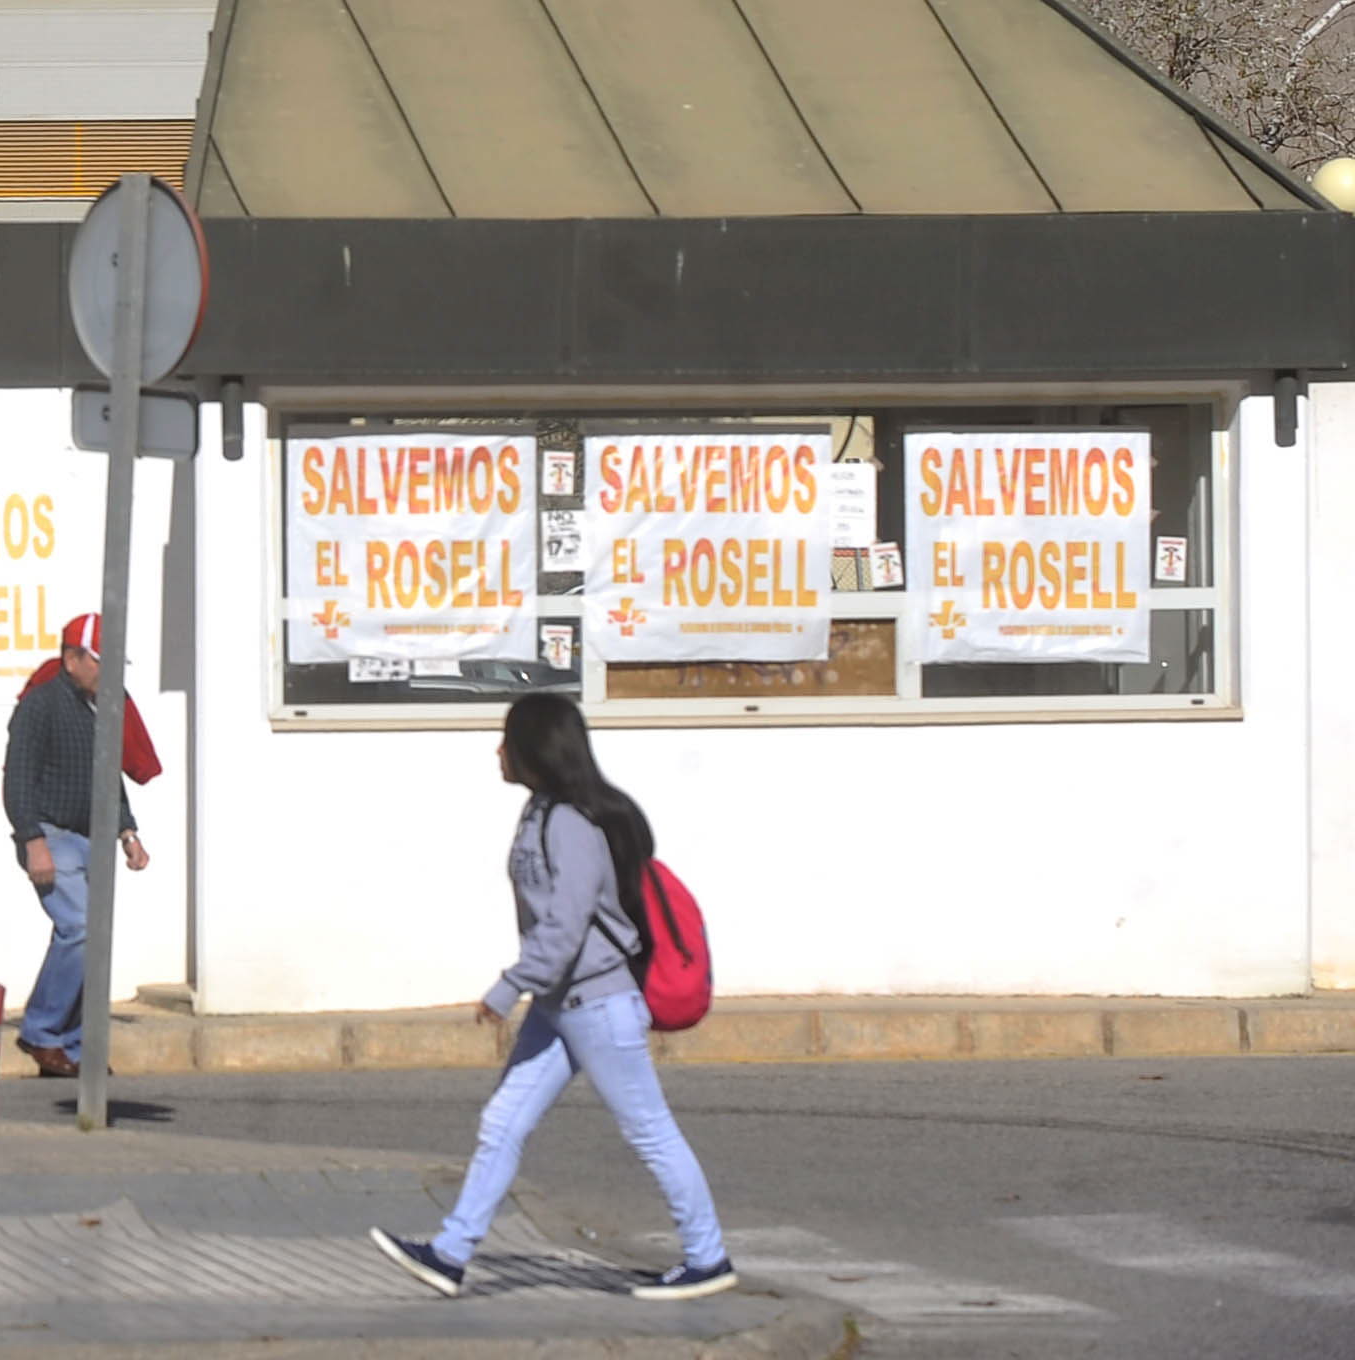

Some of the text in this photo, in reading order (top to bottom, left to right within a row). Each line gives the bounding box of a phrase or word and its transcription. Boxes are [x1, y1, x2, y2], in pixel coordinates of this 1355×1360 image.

[302, 443, 521, 516] SALVEMOS
[599, 442, 818, 515] SALVEMOS
[919, 447, 1136, 517] SALVEMOS
[315, 540, 524, 610] EL ROSELL
[612, 538, 819, 608] EL ROSELL
[932, 540, 1138, 610] EL ROSELL
